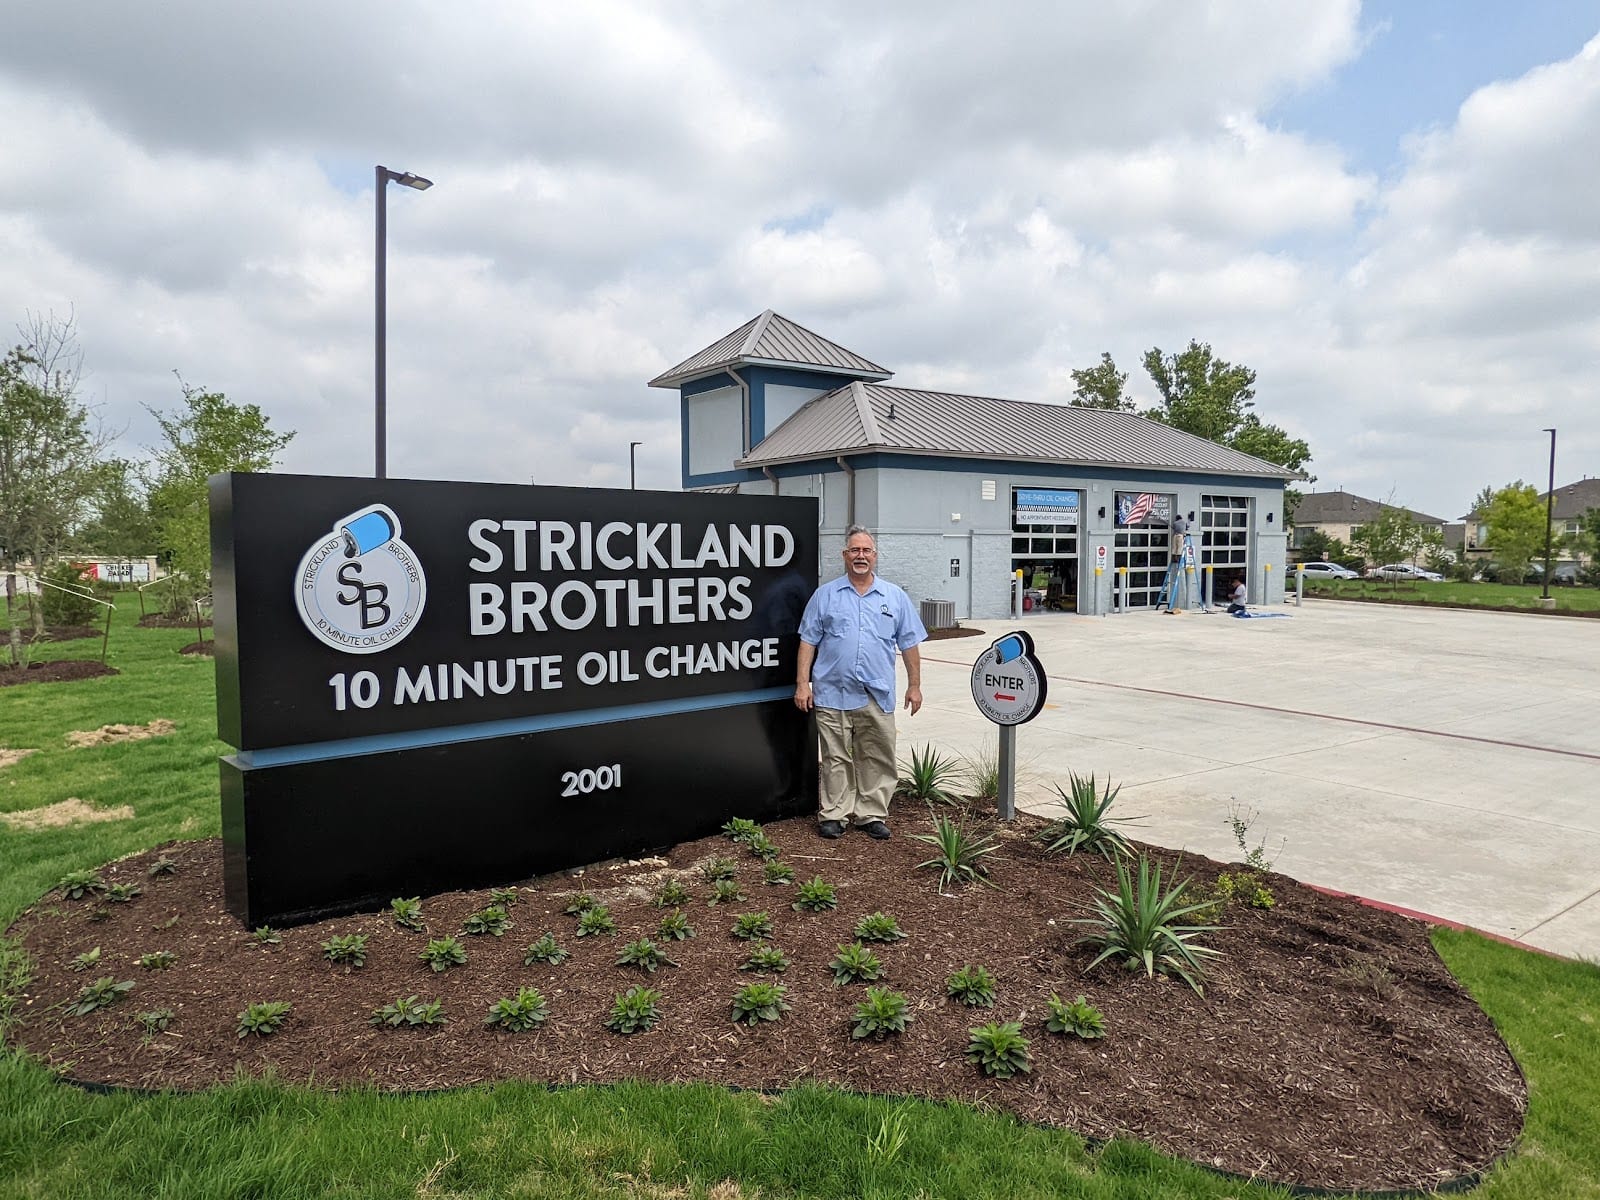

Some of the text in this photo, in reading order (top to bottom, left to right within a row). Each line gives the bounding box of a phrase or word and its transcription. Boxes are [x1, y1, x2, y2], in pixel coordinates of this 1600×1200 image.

[304, 539, 419, 590] STRICKLAND BROTHERS
[467, 518, 796, 574] STRICKLAND
[317, 611, 414, 646] 10 MINUTE OIL CHANGE
[468, 575, 753, 636] BROTHERS
[328, 637, 780, 712] 10 MINUTE OIL CHANGE
[985, 674, 1024, 690] ENTER
[561, 763, 622, 797] 2001
